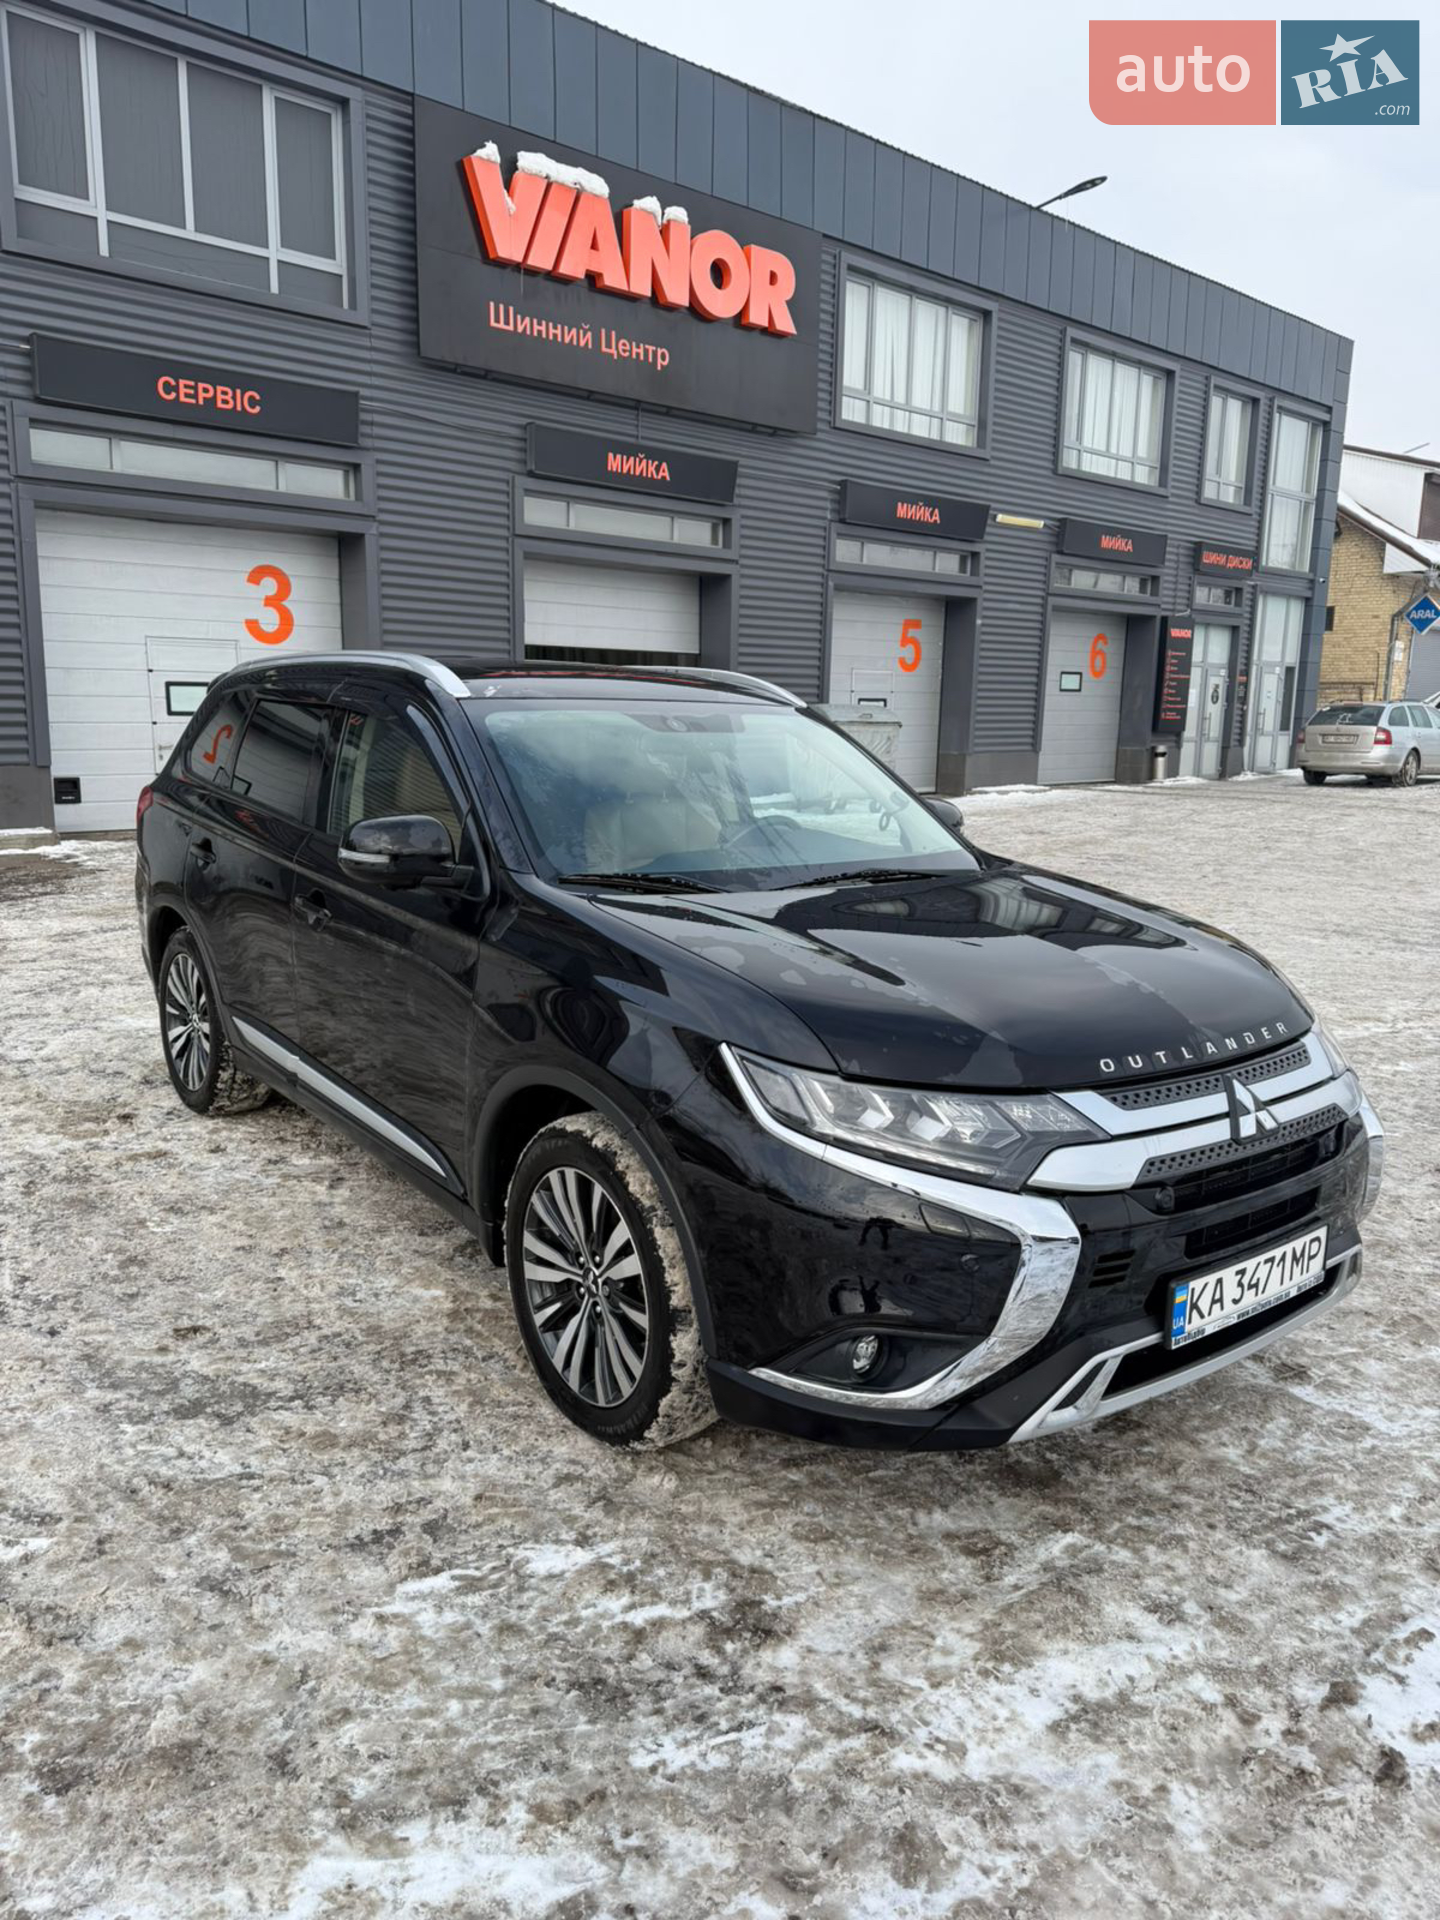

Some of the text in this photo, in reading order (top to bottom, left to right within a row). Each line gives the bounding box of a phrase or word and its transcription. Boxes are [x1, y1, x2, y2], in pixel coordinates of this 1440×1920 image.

[462, 154, 797, 337] VIANOR
[488, 300, 671, 371] Шинний Центр
[157, 376, 262, 415] СЕРВІС
[607, 452, 671, 481] МИЙКА
[896, 502, 941, 524] МИЙКА
[1101, 534, 1133, 553] МИЙКА
[1202, 551, 1253, 570] ШИНИ ДИСКИ
[244, 564, 295, 645] 3
[1410, 609, 1437, 619] ARAL
[898, 619, 922, 672] 5
[1089, 633, 1108, 679] 6
[1099, 1021, 1289, 1073] OUTLANDER
[1187, 1276, 1225, 1325] KA
